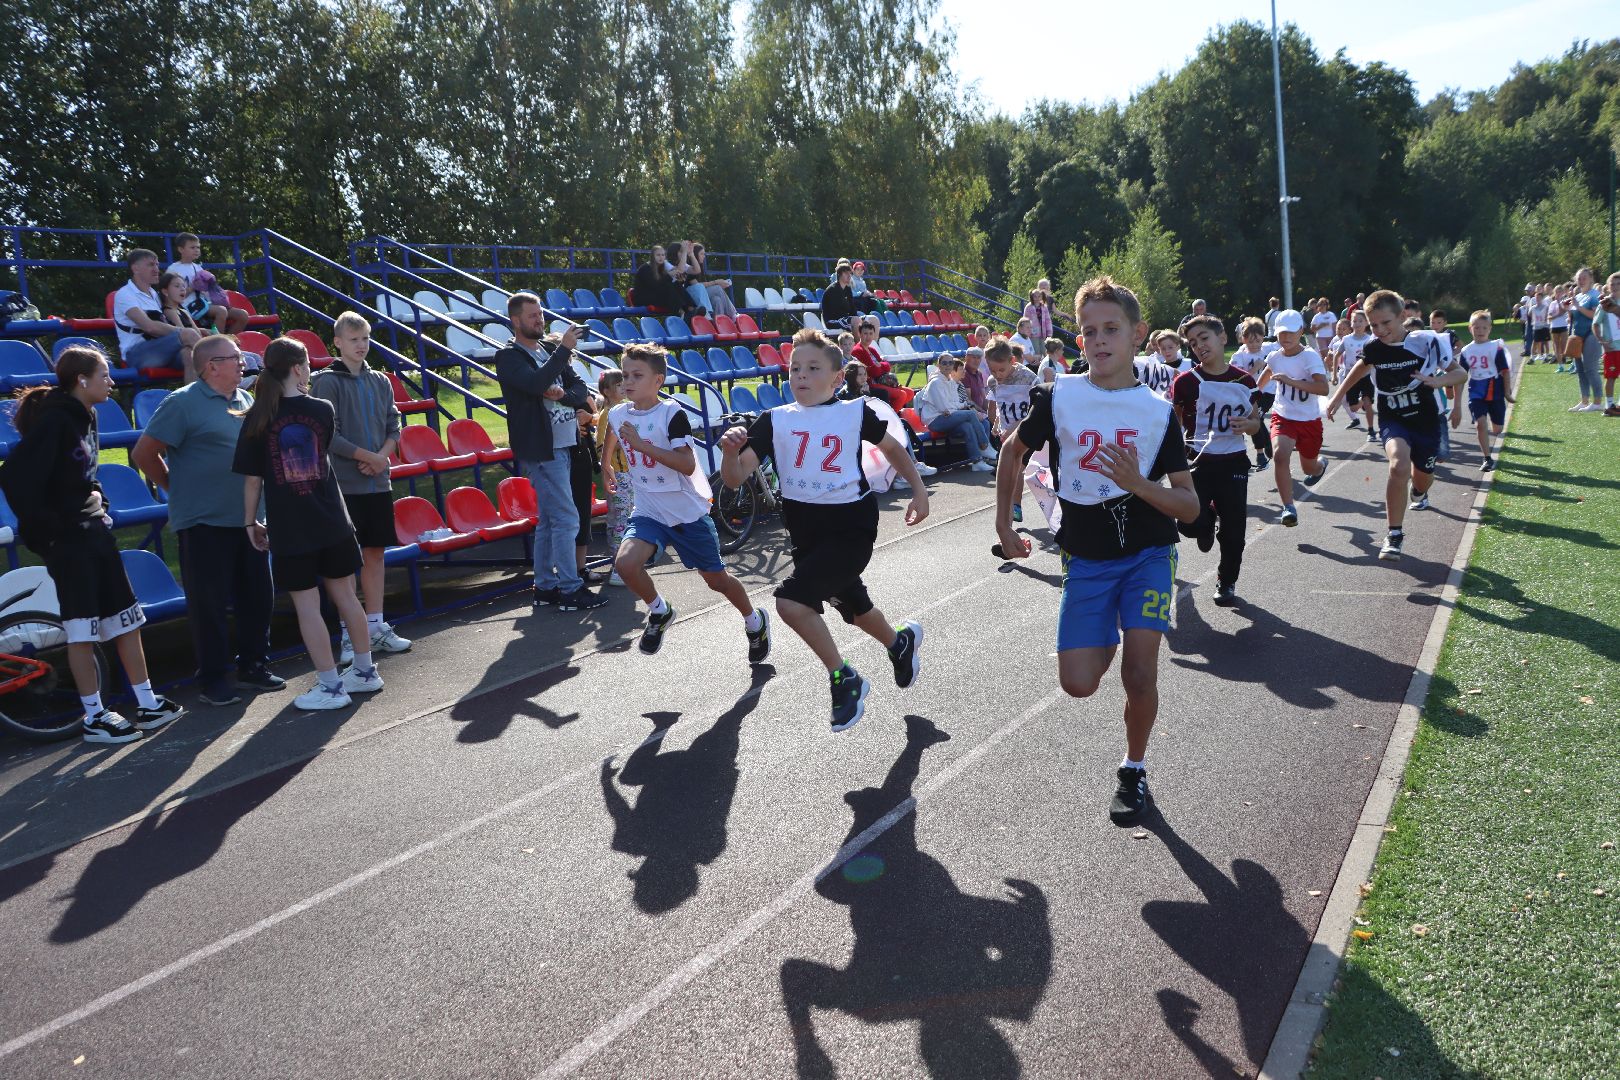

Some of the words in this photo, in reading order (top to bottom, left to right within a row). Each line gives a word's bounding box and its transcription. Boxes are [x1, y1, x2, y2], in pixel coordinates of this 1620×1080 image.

[1470, 355, 1488, 369] 29
[1386, 391, 1420, 409] ONE
[1001, 401, 1028, 424] 118
[791, 430, 842, 473] 72
[1142, 589, 1170, 620] 22
